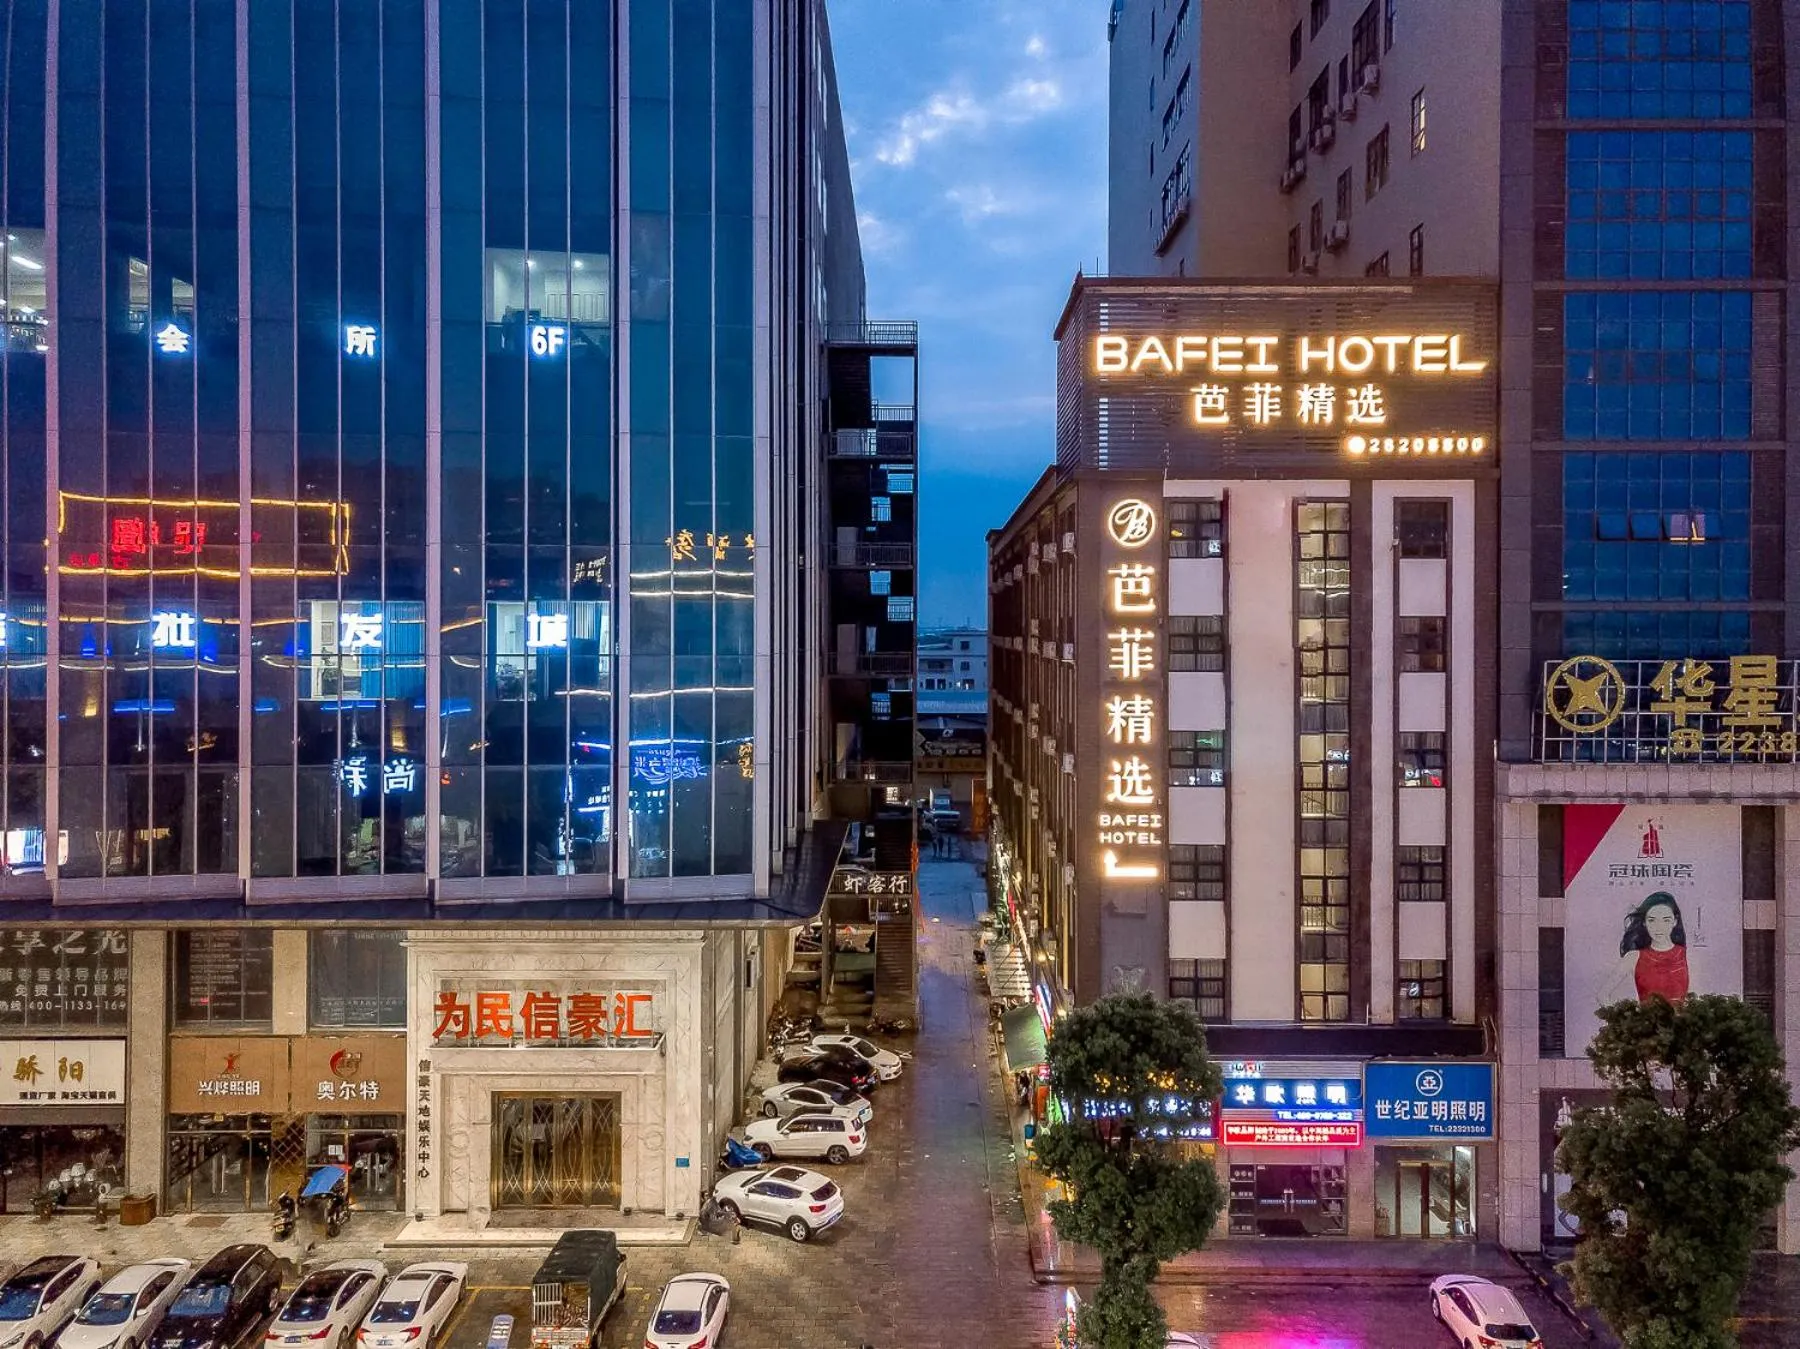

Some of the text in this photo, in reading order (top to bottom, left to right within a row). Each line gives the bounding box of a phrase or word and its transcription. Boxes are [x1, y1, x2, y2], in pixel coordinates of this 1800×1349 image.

[531, 326, 565, 354] 6F
[1095, 335, 1488, 373] BAFEI HOTEL
[1190, 384, 1387, 425] 芭菲精选
[1106, 563, 1158, 806] 芭菲精选
[1649, 655, 1782, 726] 华星
[1099, 814, 1162, 828] BAFEI
[1099, 831, 1162, 844] HOTEL
[844, 875, 907, 894] 虾客行
[432, 992, 653, 1039] 为民信豪汇
[317, 1081, 380, 1101] 奥尔特
[418, 1059, 431, 1178] 信豪天地娱乐中心
[1375, 1099, 1486, 1121] 世纪亚明照明
